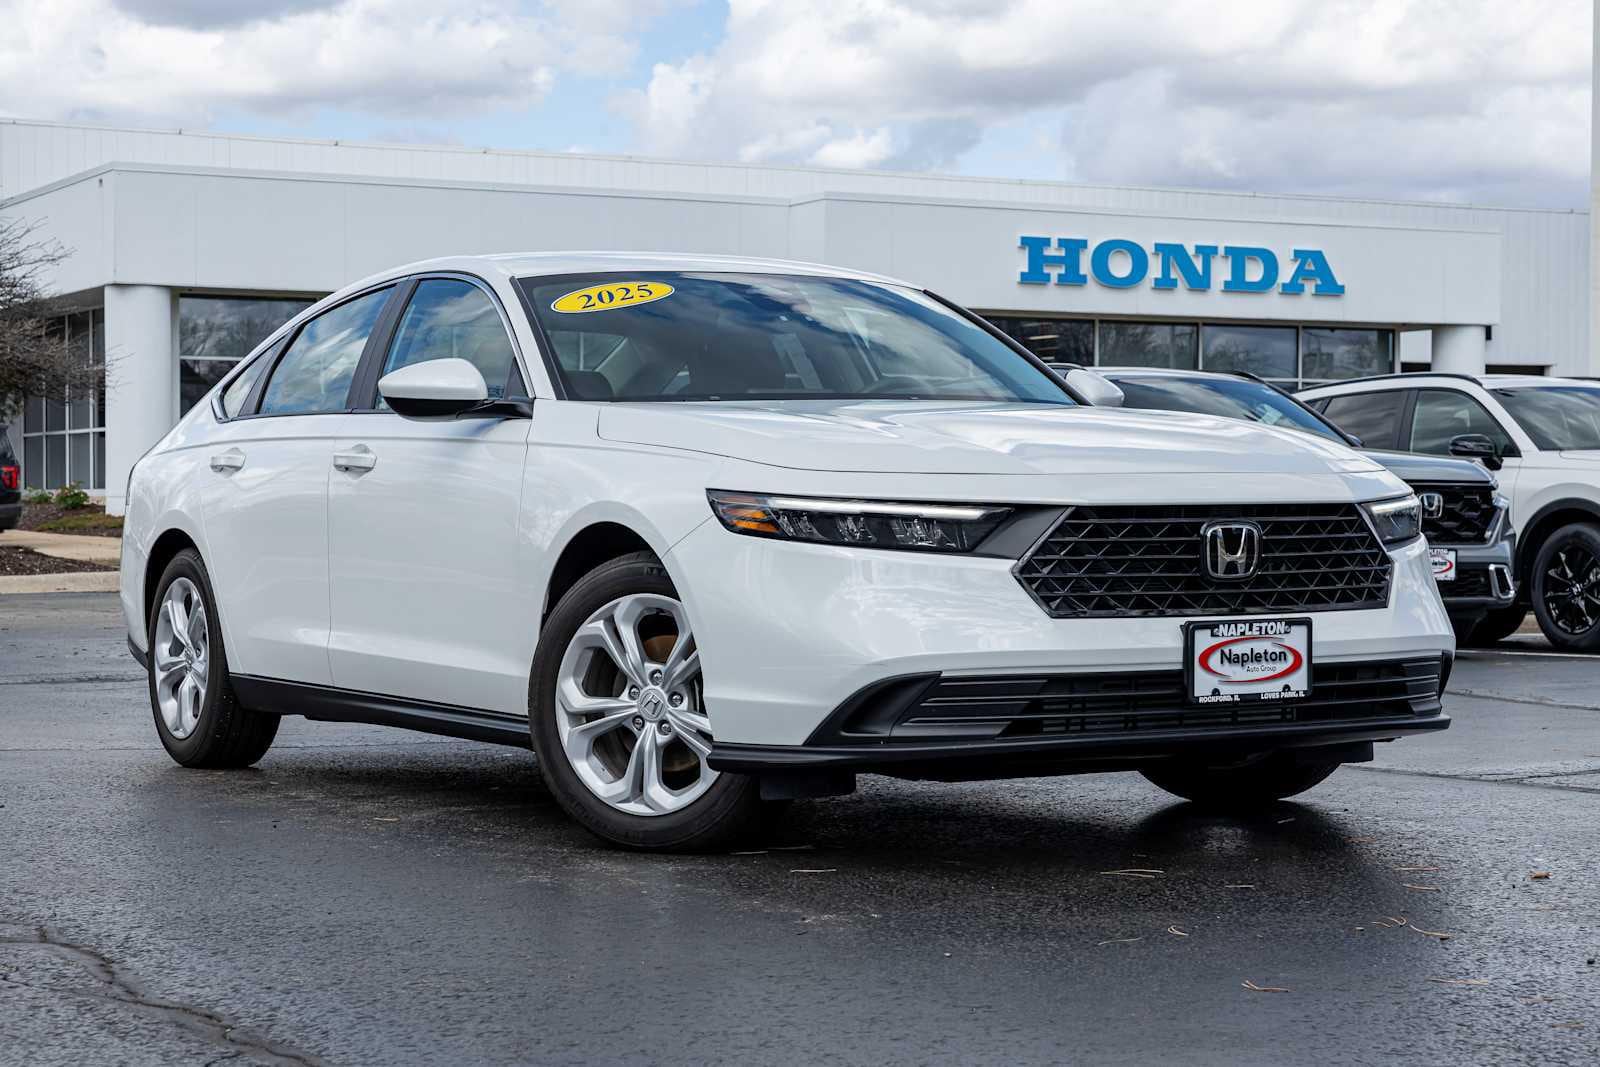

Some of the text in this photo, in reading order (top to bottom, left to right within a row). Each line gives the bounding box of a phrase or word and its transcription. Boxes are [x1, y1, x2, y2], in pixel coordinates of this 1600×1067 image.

[1018, 236, 1345, 295] HONDA
[577, 284, 653, 309] 2025
[1219, 621, 1286, 636] NAPLETON
[1220, 648, 1287, 667] Napleton
[1260, 665, 1277, 673] Group
